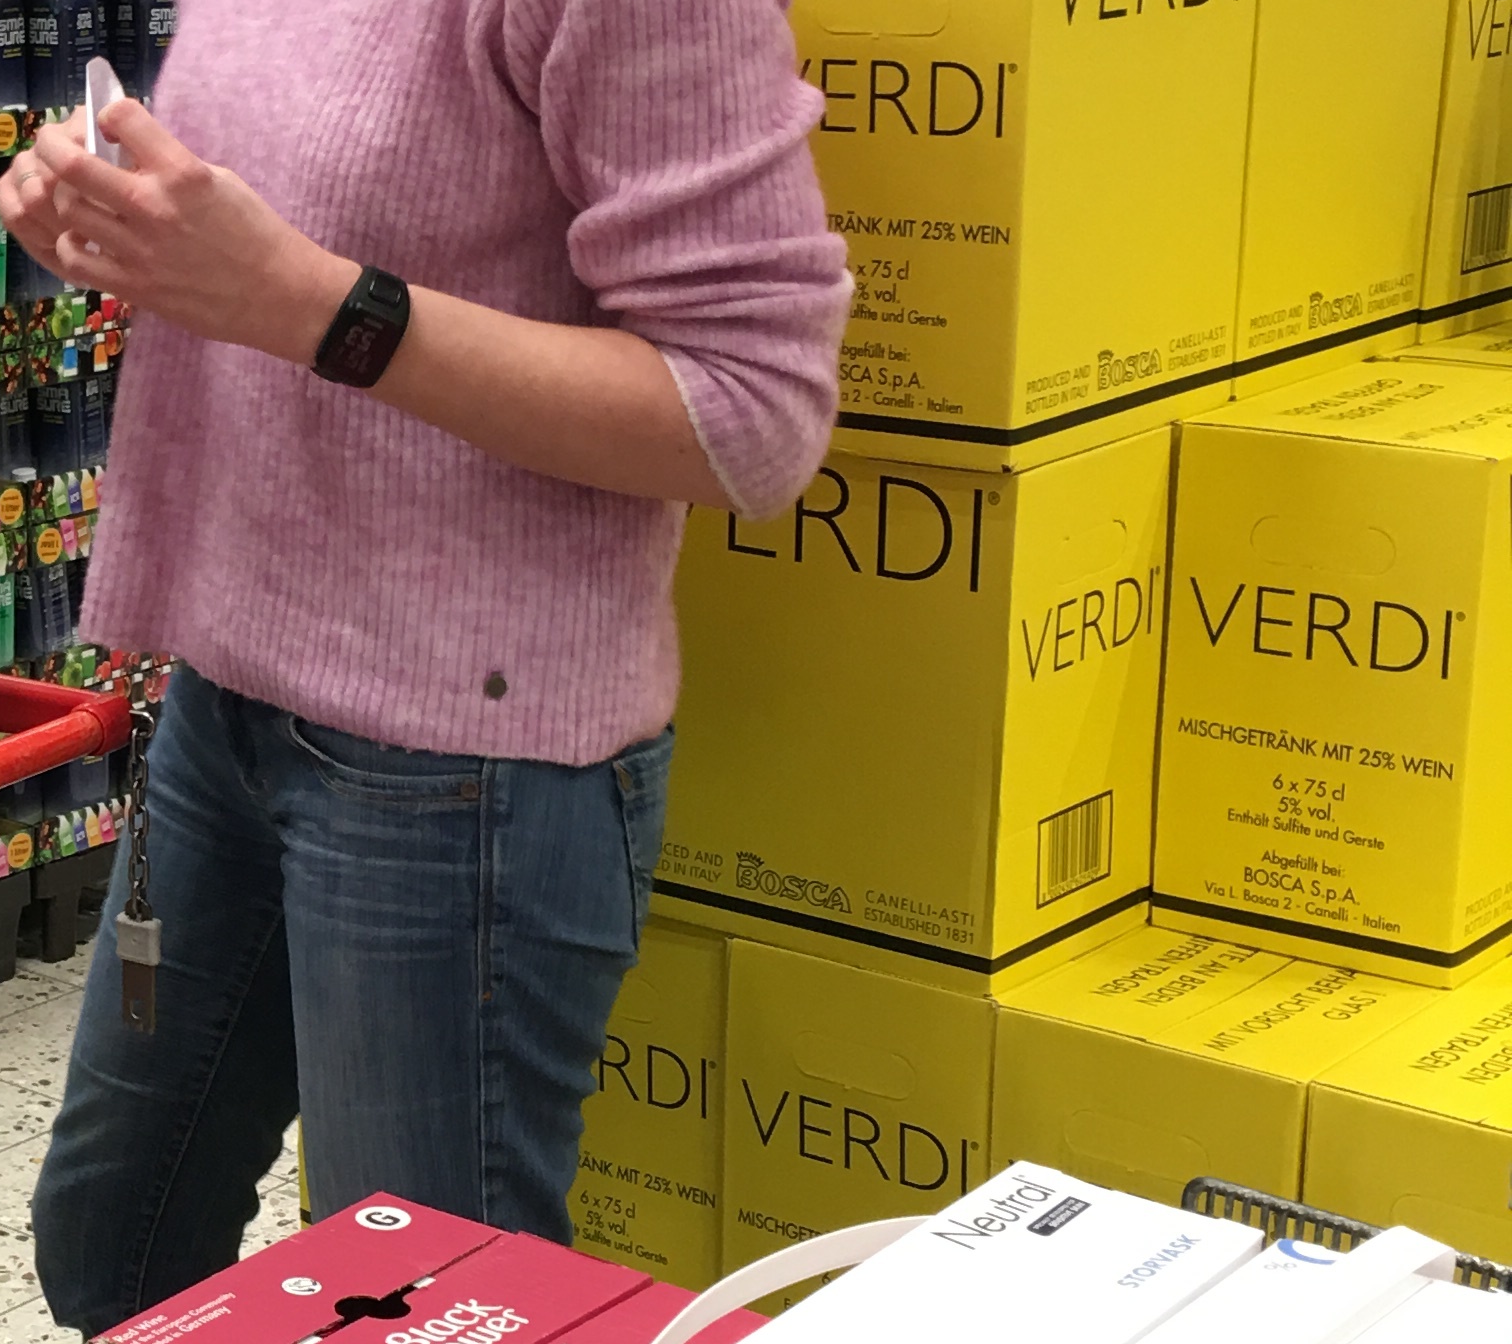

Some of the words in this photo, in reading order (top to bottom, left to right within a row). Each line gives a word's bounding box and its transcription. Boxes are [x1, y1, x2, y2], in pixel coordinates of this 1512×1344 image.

[798, 58, 1008, 139] ERDI
[1097, 349, 1163, 392] BOSCA
[1020, 567, 1156, 683] VERDI
[1189, 575, 1454, 681] VERDI
[1178, 718, 1317, 757] MISCHGETRÄNK
[1322, 742, 1354, 763] MIT
[1359, 748, 1396, 771] 25%
[1402, 755, 1453, 781] WEIN
[1273, 774, 1283, 790] 6
[1288, 780, 1298, 793] x
[1304, 778, 1326, 798] 75
[1332, 783, 1345, 801] cl
[1278, 796, 1303, 816] 5%
[1308, 803, 1335, 823] vol.
[1228, 808, 1269, 827] Enthält
[1273, 819, 1310, 837] Sulfite
[1315, 826, 1339, 841] und
[1343, 830, 1385, 850] Gerste
[736, 864, 852, 914] BOSCA
[1244, 867, 1304, 894] BOSCA
[1261, 850, 1318, 873] Abgefüllt
[1322, 858, 1345, 878] bei:
[864, 907, 942, 937] ESTABLISHED
[945, 927, 975, 945] 1831
[865, 890, 975, 928] CANELLI-ASTI
[1205, 880, 1225, 897] Via
[1243, 889, 1279, 908] Bosca
[1305, 902, 1348, 922] Canelli
[1363, 914, 1400, 934] Italien
[740, 1077, 972, 1199] VERDI
[930, 1175, 1056, 1250] Neutral
[1117, 1233, 1201, 1288] STORVASK
